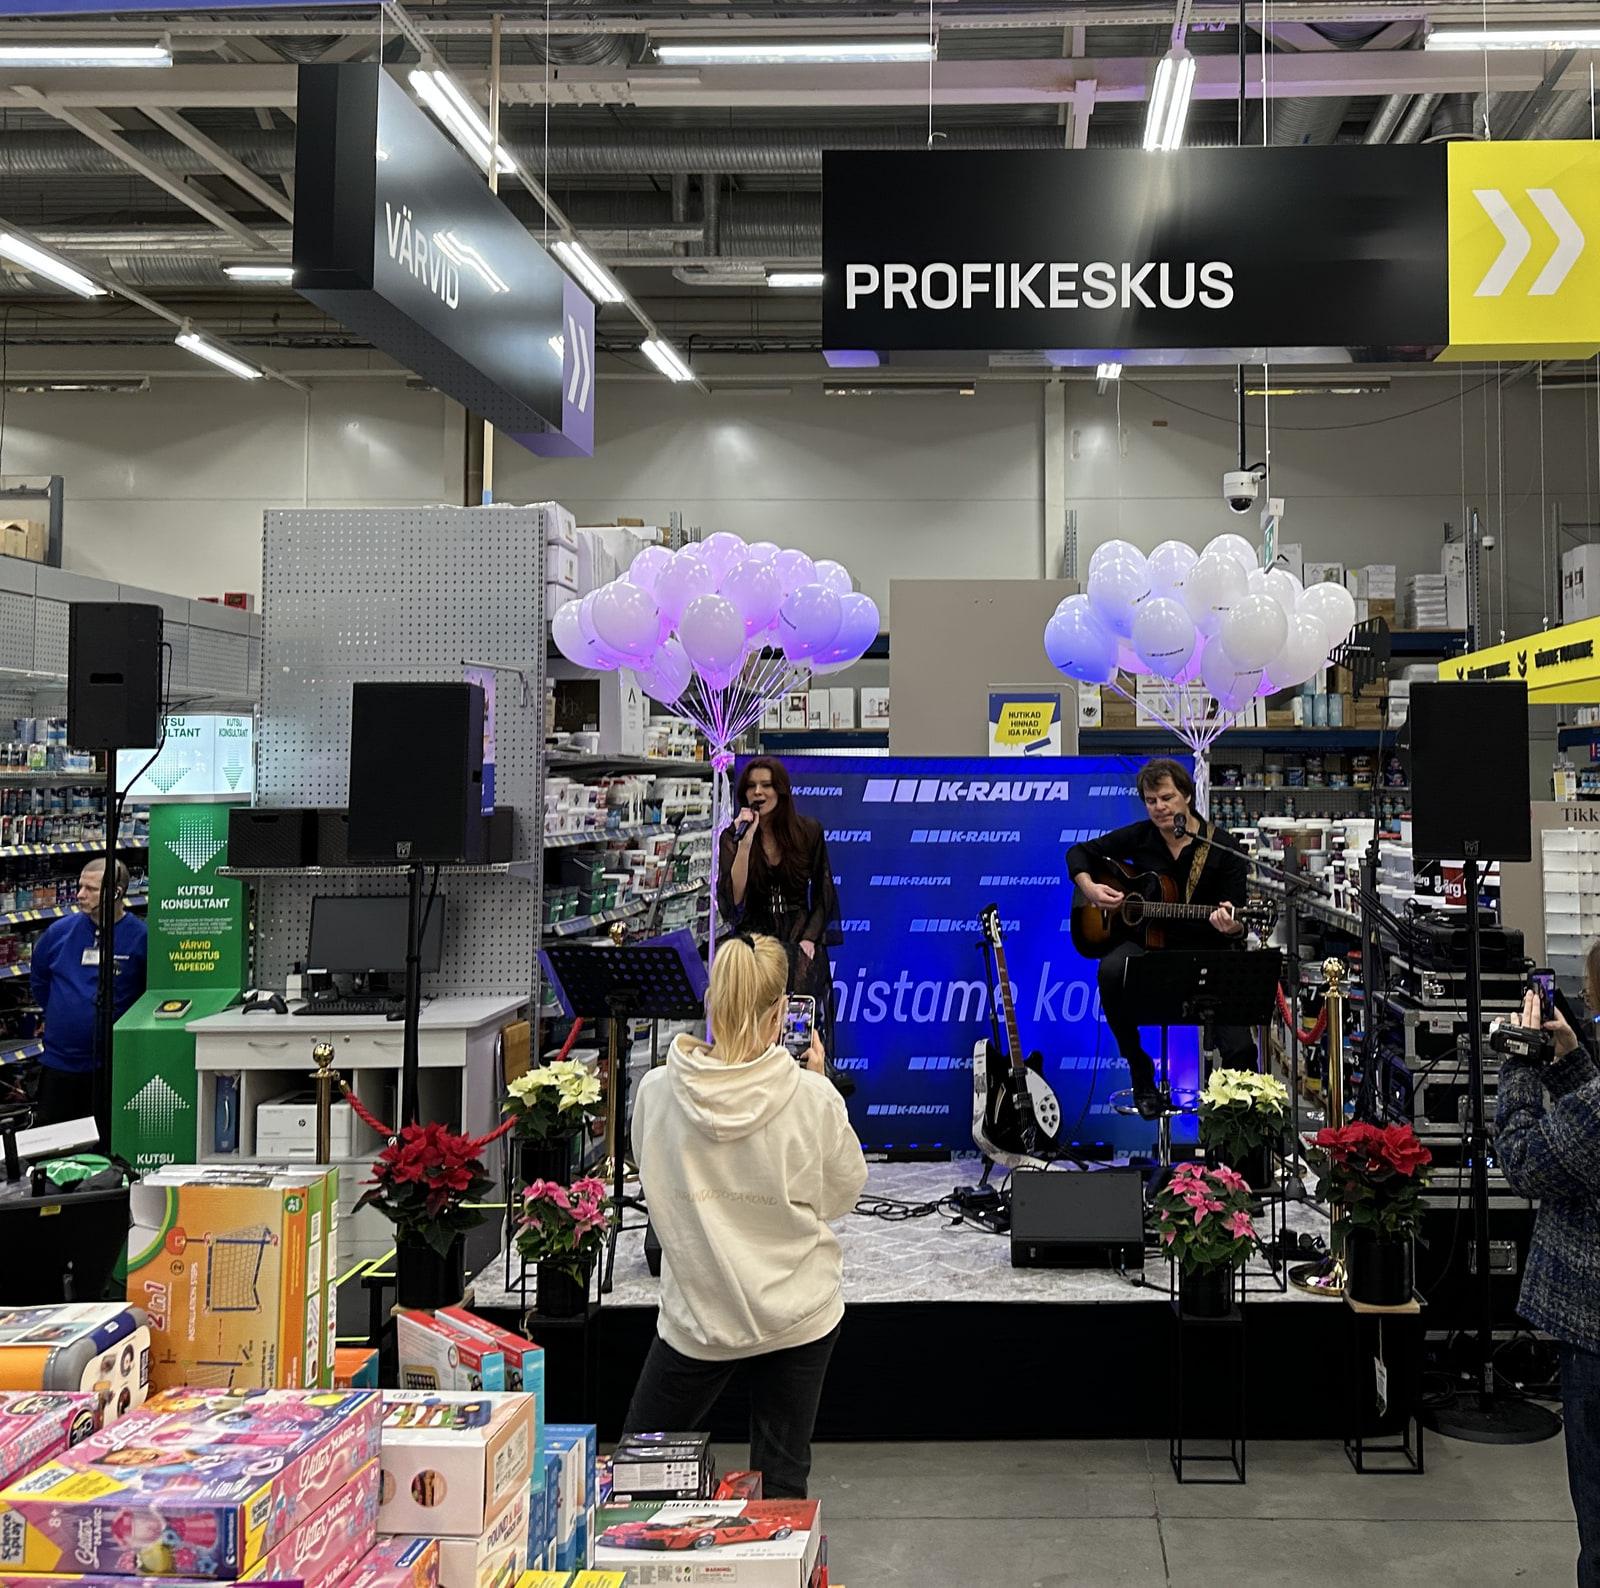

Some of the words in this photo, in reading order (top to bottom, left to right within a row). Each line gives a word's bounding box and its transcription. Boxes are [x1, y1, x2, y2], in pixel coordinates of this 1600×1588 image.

[384, 202, 460, 311] VÄRVID
[846, 261, 1235, 310] PROFIKESKUS
[1008, 711, 1041, 719] NUTIKAD
[226, 718, 243, 727] KUTSU
[1010, 720, 1039, 728] HINNAD
[218, 728, 248, 738] KONSULTANT
[1022, 727, 1042, 737] PÄEV
[791, 786, 843, 797] K-RAUTA
[938, 780, 1069, 802] K-RAUTA
[950, 830, 1021, 843] K-RAUTA
[899, 876, 951, 887] K-RAUTA
[1009, 876, 1061, 886] K-RAUTA
[177, 885, 214, 896] KUTSU
[161, 898, 230, 910] KONSULTANT
[179, 939, 211, 949] VÄRVID
[169, 951, 220, 960] VALGUSTUS
[174, 962, 215, 972] TAPEEDID
[897, 1104, 950, 1115] K-RAUTA
[136, 1153, 175, 1164] KUTSU
[49, 1508, 61, 1528] 8+
